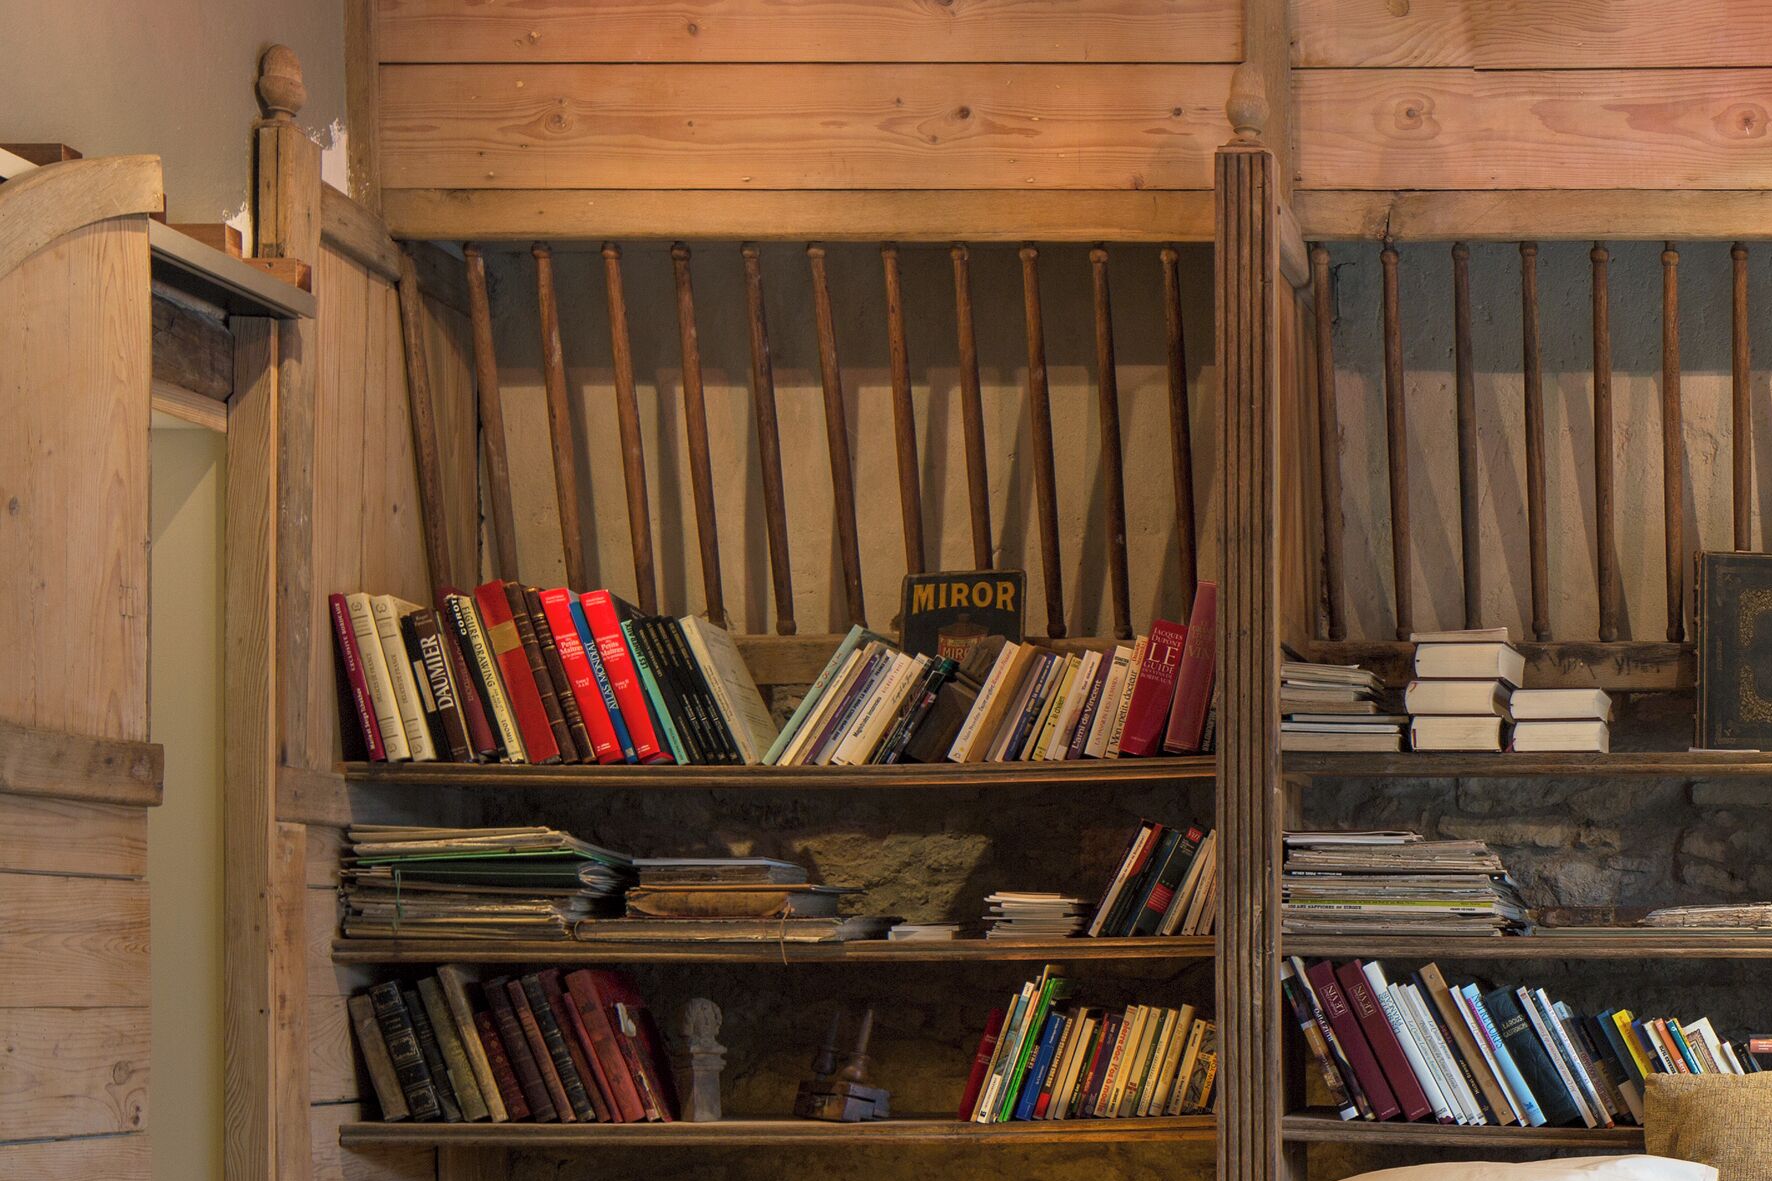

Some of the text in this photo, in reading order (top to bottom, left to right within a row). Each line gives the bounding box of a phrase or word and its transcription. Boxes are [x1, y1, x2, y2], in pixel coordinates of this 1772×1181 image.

[912, 581, 1016, 615] MIROR
[449, 597, 468, 636] COROT
[460, 604, 481, 643] FIGURE
[472, 641, 496, 688] DRAWING
[1154, 627, 1183, 641] JACQUES
[637, 656, 649, 670] LES
[1143, 661, 1174, 674] GUIDE
[1147, 642, 1179, 667] LE
[418, 633, 455, 711] DAUMIER
[584, 639, 618, 711] ATLAS MONDIAL
[1070, 677, 1103, 750] L'ami de Vincent
[1108, 726, 1124, 747] Mon
[1120, 669, 1139, 701] docteur
[1324, 983, 1346, 1014] LE VIN
[1353, 984, 1375, 1014] LE VIN
[1116, 1020, 1130, 1045] pierre
[1312, 1006, 1334, 1042] RUIZ PIPO
[1470, 992, 1506, 1050] NOTRE CORPS
[1111, 1044, 1123, 1061] dac
[1104, 1077, 1113, 1085] à
[1106, 1062, 1117, 1078] l'os
[1203, 1072, 1213, 1089] NEW
